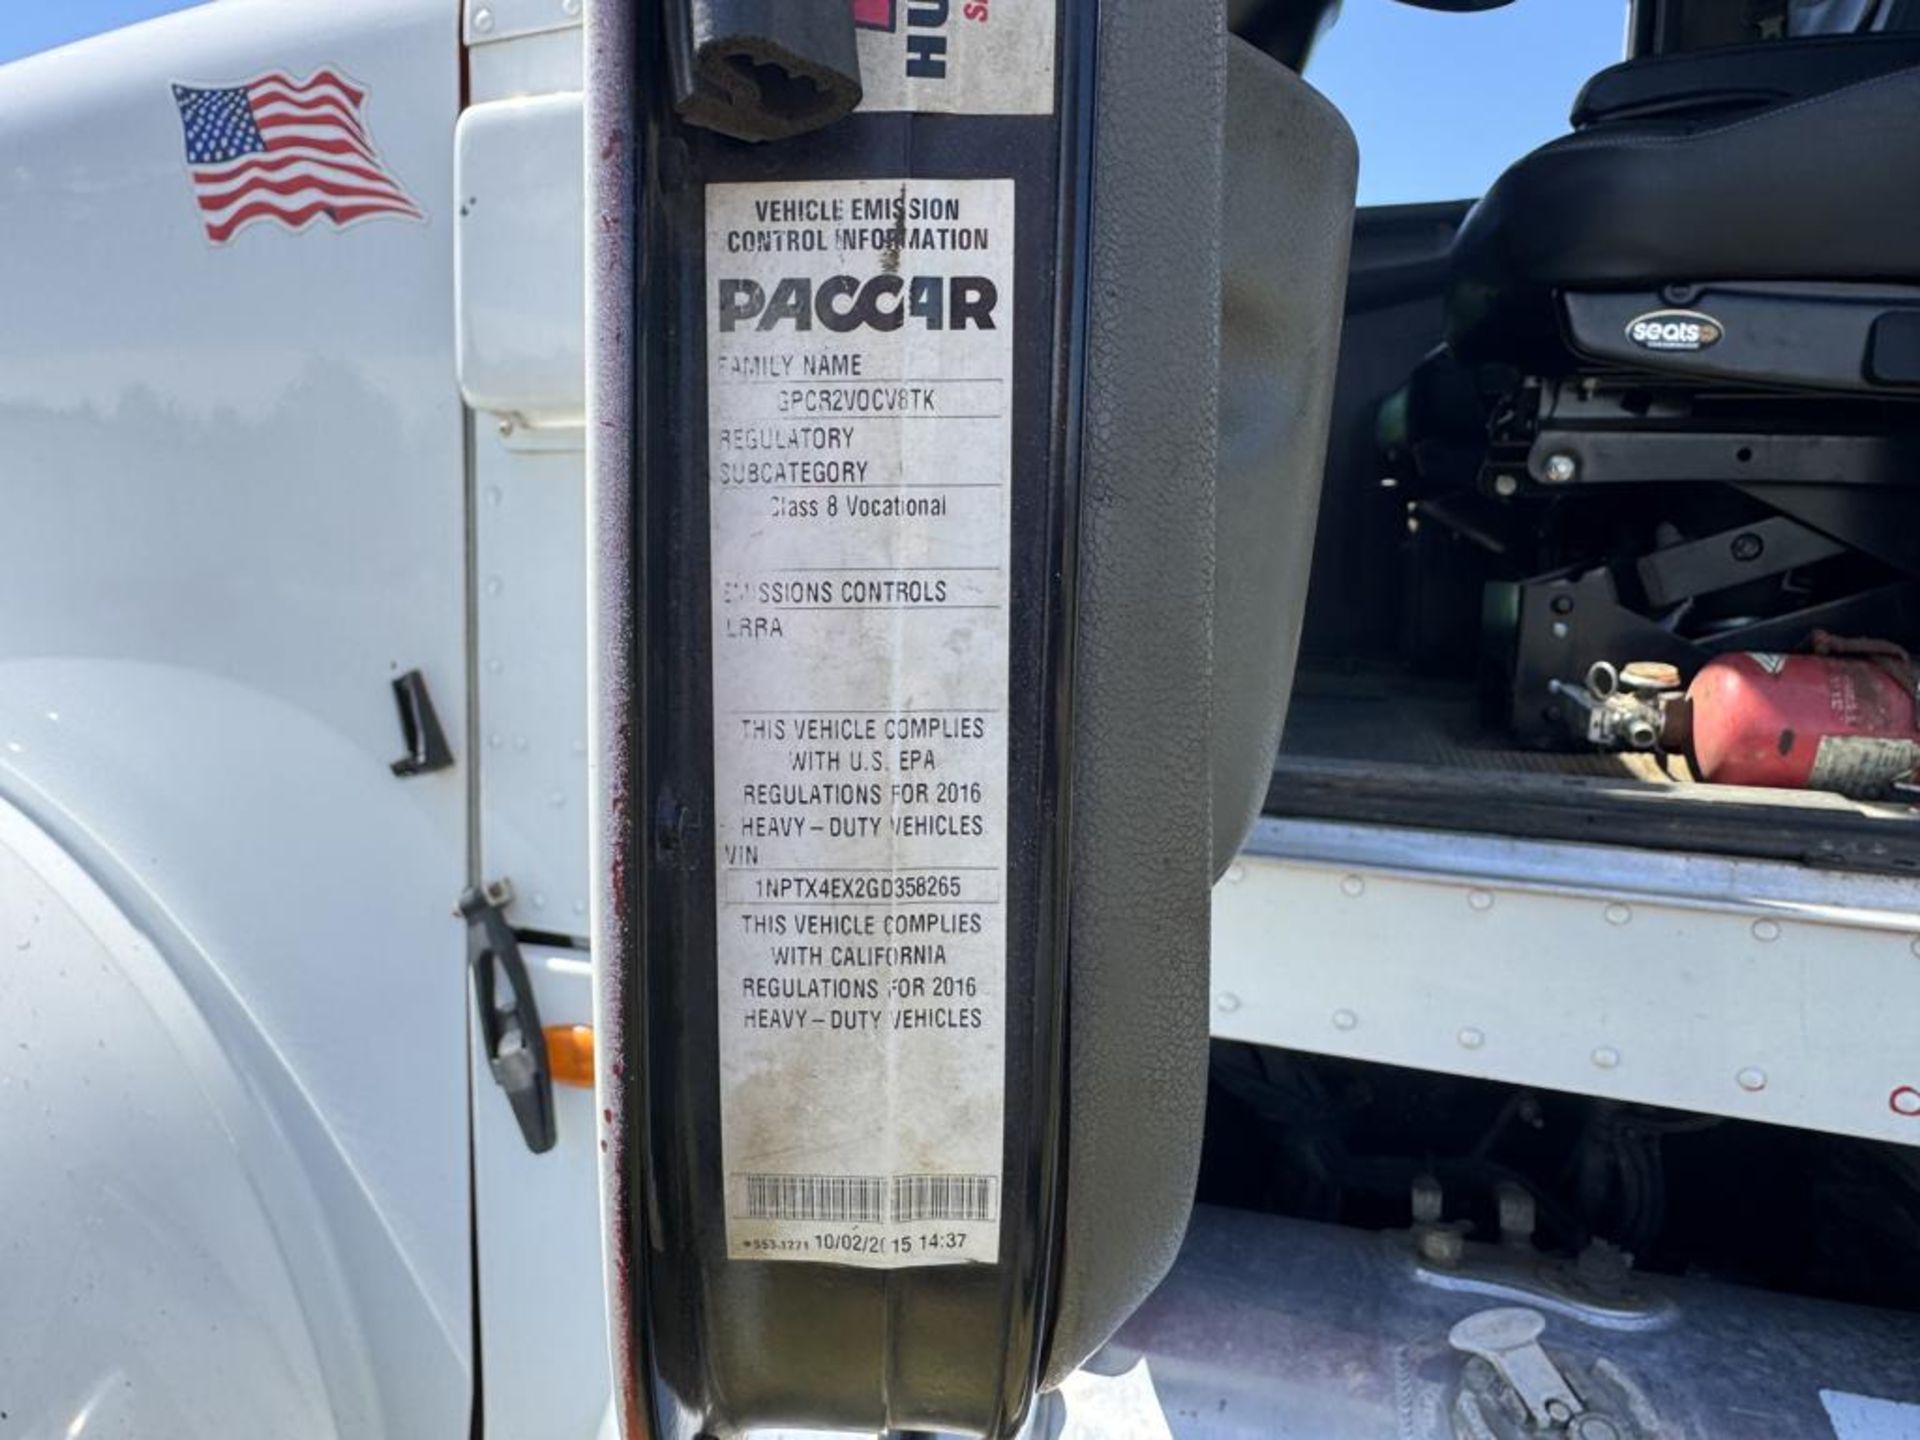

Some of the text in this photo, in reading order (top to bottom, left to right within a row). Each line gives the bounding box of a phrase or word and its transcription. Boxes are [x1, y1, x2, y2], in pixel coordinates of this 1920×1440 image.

[963, 0, 988, 23] S
[756, 198, 960, 222] VEHICLE EMISSION
[728, 228, 989, 253] CONTROL INFORMATION
[718, 275, 998, 333] PACCAR
[1632, 322, 1700, 341] seats
[803, 354, 862, 376] NAME
[719, 427, 854, 449] REGULATORY
[719, 461, 868, 485] SUBCATEGORY
[827, 494, 838, 517] 8
[847, 494, 946, 517] Vocational
[723, 580, 947, 604] SSIONS CONTROLS
[742, 717, 985, 741] THIS VEHICLE COMPLIES
[790, 750, 937, 772] WITH U.S. EPA
[743, 782, 982, 805] REGULATIONS FOR 2016
[890, 815, 984, 837] VEHICLES
[724, 844, 759, 865] VIN
[754, 876, 962, 899] 1NPTX4EX2GD358265
[741, 913, 982, 936] THIS VEHICLE COMPLIES
[771, 945, 946, 967] WITH CALIFORNIA
[742, 978, 879, 999] REGULATIONS
[932, 977, 977, 998] 2016
[919, 1231, 967, 1250] 14:37
